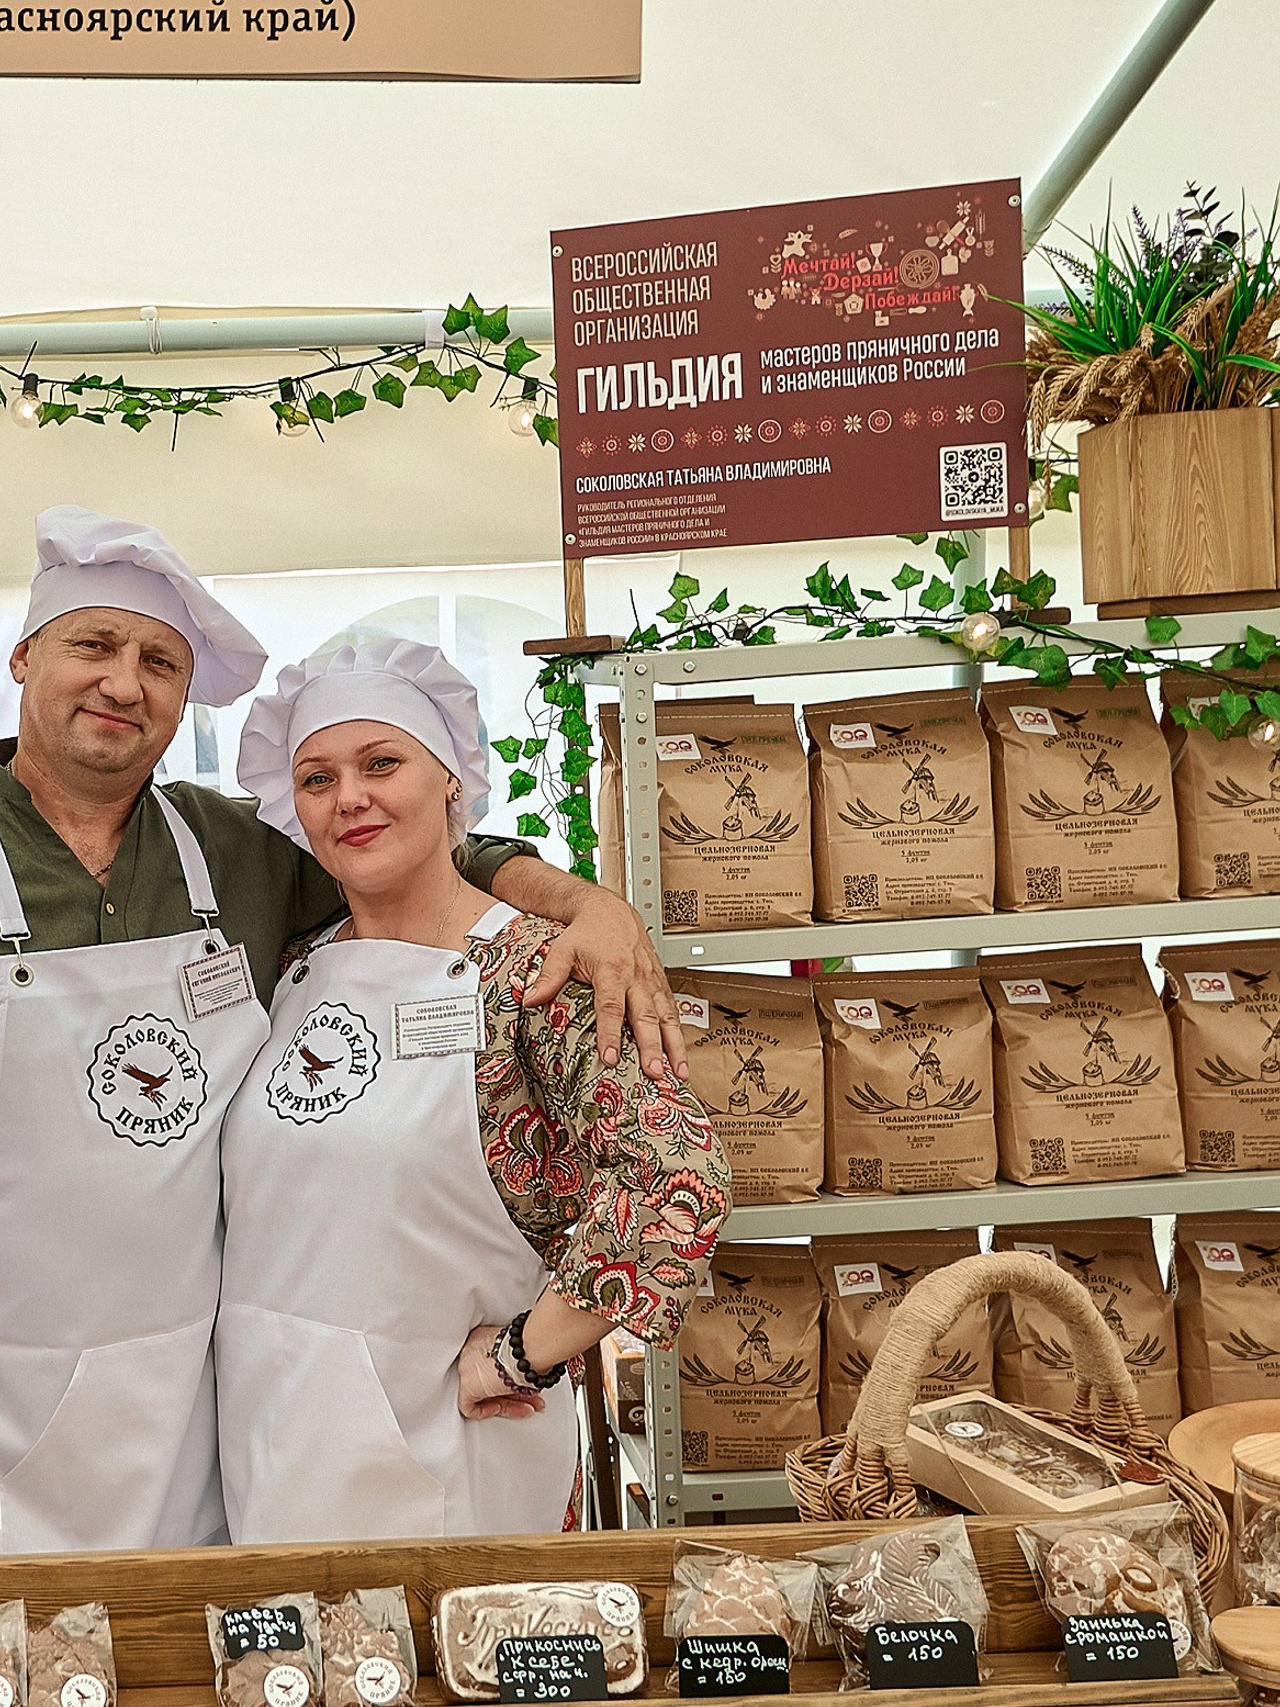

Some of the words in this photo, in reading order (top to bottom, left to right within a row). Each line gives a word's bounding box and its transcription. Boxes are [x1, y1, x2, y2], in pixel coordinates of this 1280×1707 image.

[242, 0, 356, 42] край)
[571, 241, 718, 283] ВСЕРОССИЙСКАЯ
[781, 252, 855, 279] Мечтай!
[824, 266, 899, 292] Дерзай!
[572, 275, 711, 315] ОБЩЕСТВЕННАЯ
[864, 285, 957, 309] Побеждай!
[574, 309, 699, 347] ОРГАНИЗАЦИЯ
[760, 343, 842, 370] мастеров
[847, 330, 949, 363] пряничного
[954, 327, 999, 354] дела
[576, 352, 743, 414] ГИЛЬДИЯ
[761, 378, 772, 394] и
[776, 365, 898, 393] знаменщиков
[903, 357, 966, 383] России
[576, 473, 663, 494] СОКОЛОВСКАЯ
[668, 466, 723, 486] ТАТЬЯНА
[726, 457, 831, 481] ВЛАДИМИРОВНА
[578, 501, 625, 513] РУКОВОДИТЕЛЬ
[679, 493, 716, 505] ОТДЕЛЕНИЯ
[578, 512, 628, 524] ВСЕРОССИЙСКОЙ
[629, 508, 679, 521] ОБЩЕСТВЕННОЙ
[680, 505, 726, 516] ОРГАНИЗАЦИИ
[612, 523, 644, 534] МАСТЕРОВ
[645, 520, 685, 532] ПРЯНИЧНОГО
[686, 519, 704, 529] ДЕЛА
[661, 530, 710, 542] КРАСНОЯРСКОМ
[711, 528, 727, 538] КРАЕ
[1043, 730, 1124, 748] СОКОЛОВСКАЯ
[1066, 741, 1097, 750] МУКА
[860, 740, 947, 759] СОКОЛОВСКАЯ
[886, 747, 921, 757] МУКА
[684, 753, 769, 774] СОКОЛОВСКАЯ
[710, 765, 743, 774] МУКА
[872, 828, 956, 838] ЦЕЛЬНОЗЕРНОВАЯ
[1055, 818, 1138, 831] ЦЕЛЬНОЗЕРНОВАЯ
[694, 845, 776, 854] ЦЕЛЬНОЗЕРНОВАЯ
[1039, 1001, 1122, 1020] СОКОЛОВСКАЯ
[1063, 1009, 1098, 1020] МУКА
[1245, 1003, 1278, 1014] МУКА
[694, 1026, 781, 1047] СОКОЛОВСКАЯ
[720, 1037, 754, 1047] МУКА
[870, 1022, 953, 1044] СОКОЛОВСКАЯ
[893, 1030, 928, 1042] МУКА
[282, 1014, 368, 1077] СОКОЛОВСКИЙ
[101, 1028, 198, 1095] СОКОЛОВСКИЙ
[276, 1082, 347, 1113] ПРЯНИК
[1056, 1089, 1138, 1102] ЦЕЛЬНОЗЕРНОВАЯ
[115, 1096, 194, 1134] ПРЯНИК
[878, 1112, 960, 1124] ЦЕЛЬНОЗЕРНОВАЯ
[712, 1120, 782, 1129] ЛЬНОЗЕРНОВАЯ
[700, 1293, 783, 1318] СОКОЛОВСКАЯ
[724, 1306, 758, 1317] МУКА
[706, 1389, 788, 1399] ЦЕЛЬНОЗЕРНОВАЯ
[257, 1634, 279, 1649] 50
[875, 1627, 958, 1645] Белочка
[687, 1639, 760, 1656] Шишка
[908, 1645, 943, 1661] 150
[1107, 1645, 1139, 1660] 150
[716, 1671, 746, 1685] 150
[534, 1682, 570, 1698] 300
